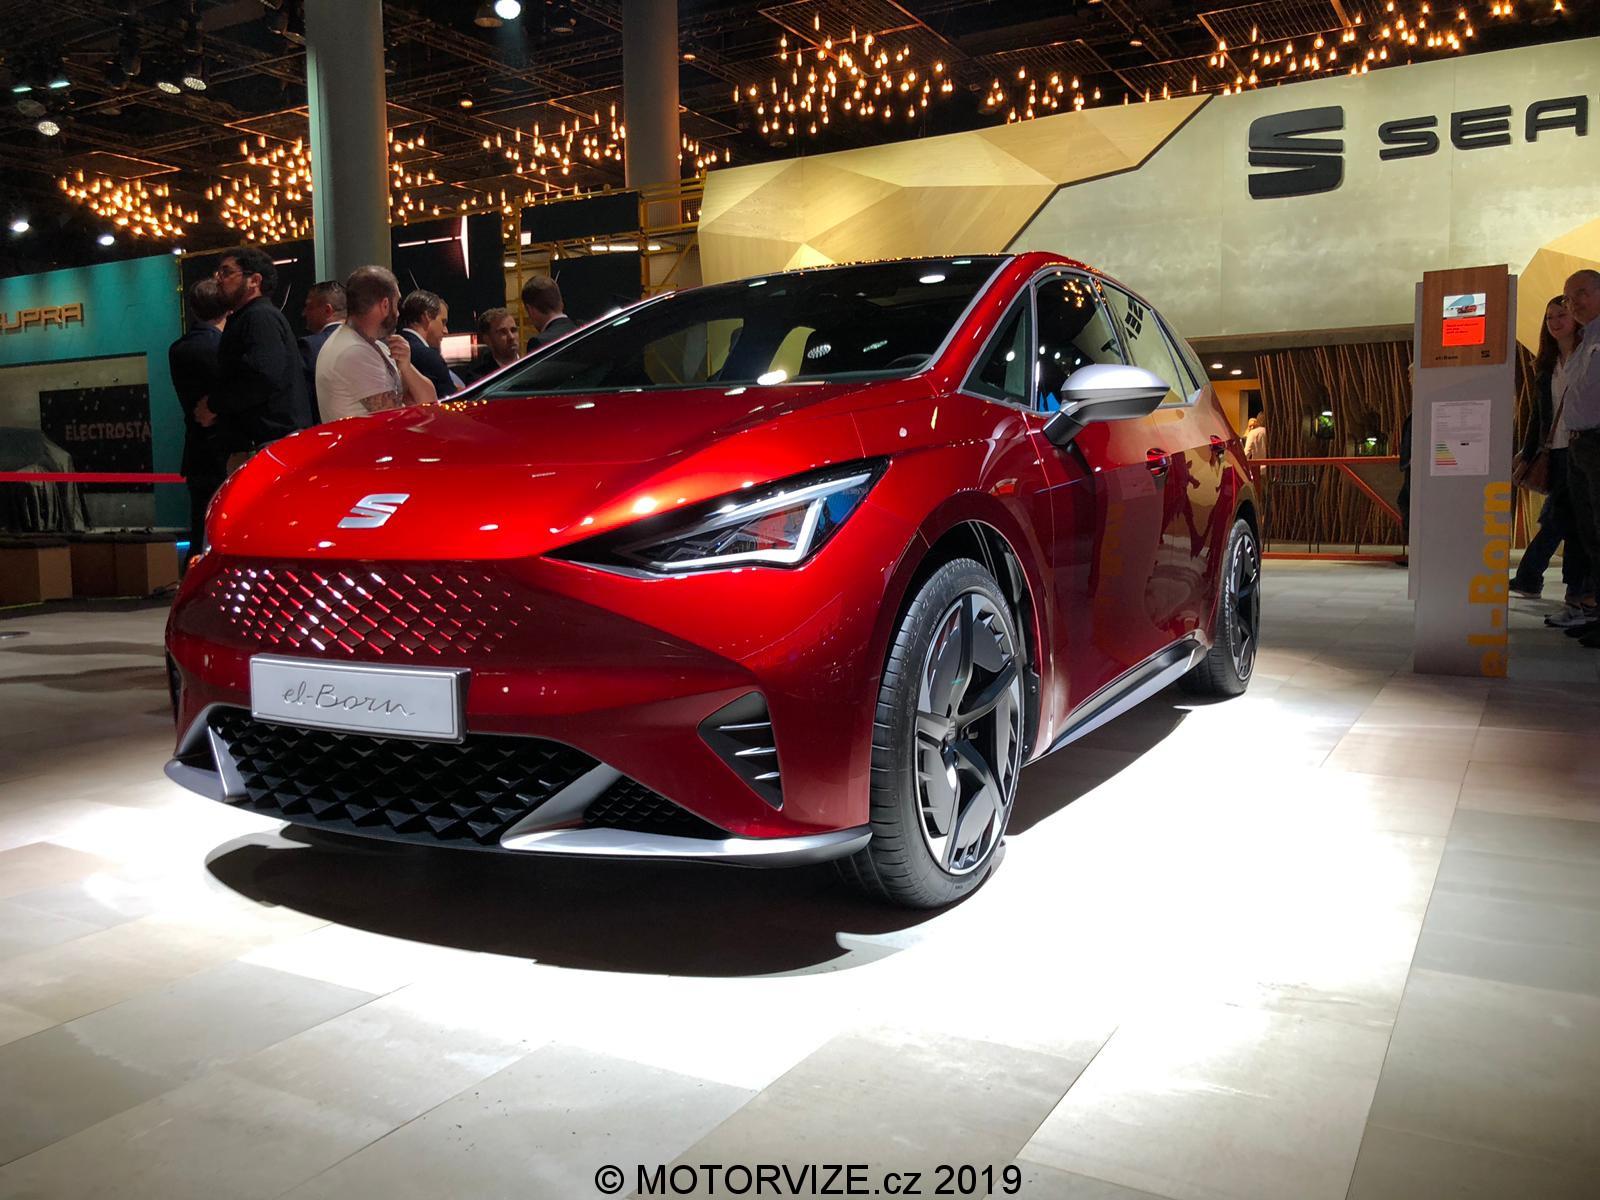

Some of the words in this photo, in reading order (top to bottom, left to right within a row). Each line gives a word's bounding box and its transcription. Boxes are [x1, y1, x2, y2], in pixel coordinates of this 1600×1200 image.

[1378, 95, 1588, 161] SEA
[0, 303, 84, 330] UPRA
[1467, 481, 1511, 678] el-Born
[282, 680, 416, 717] el-Born
